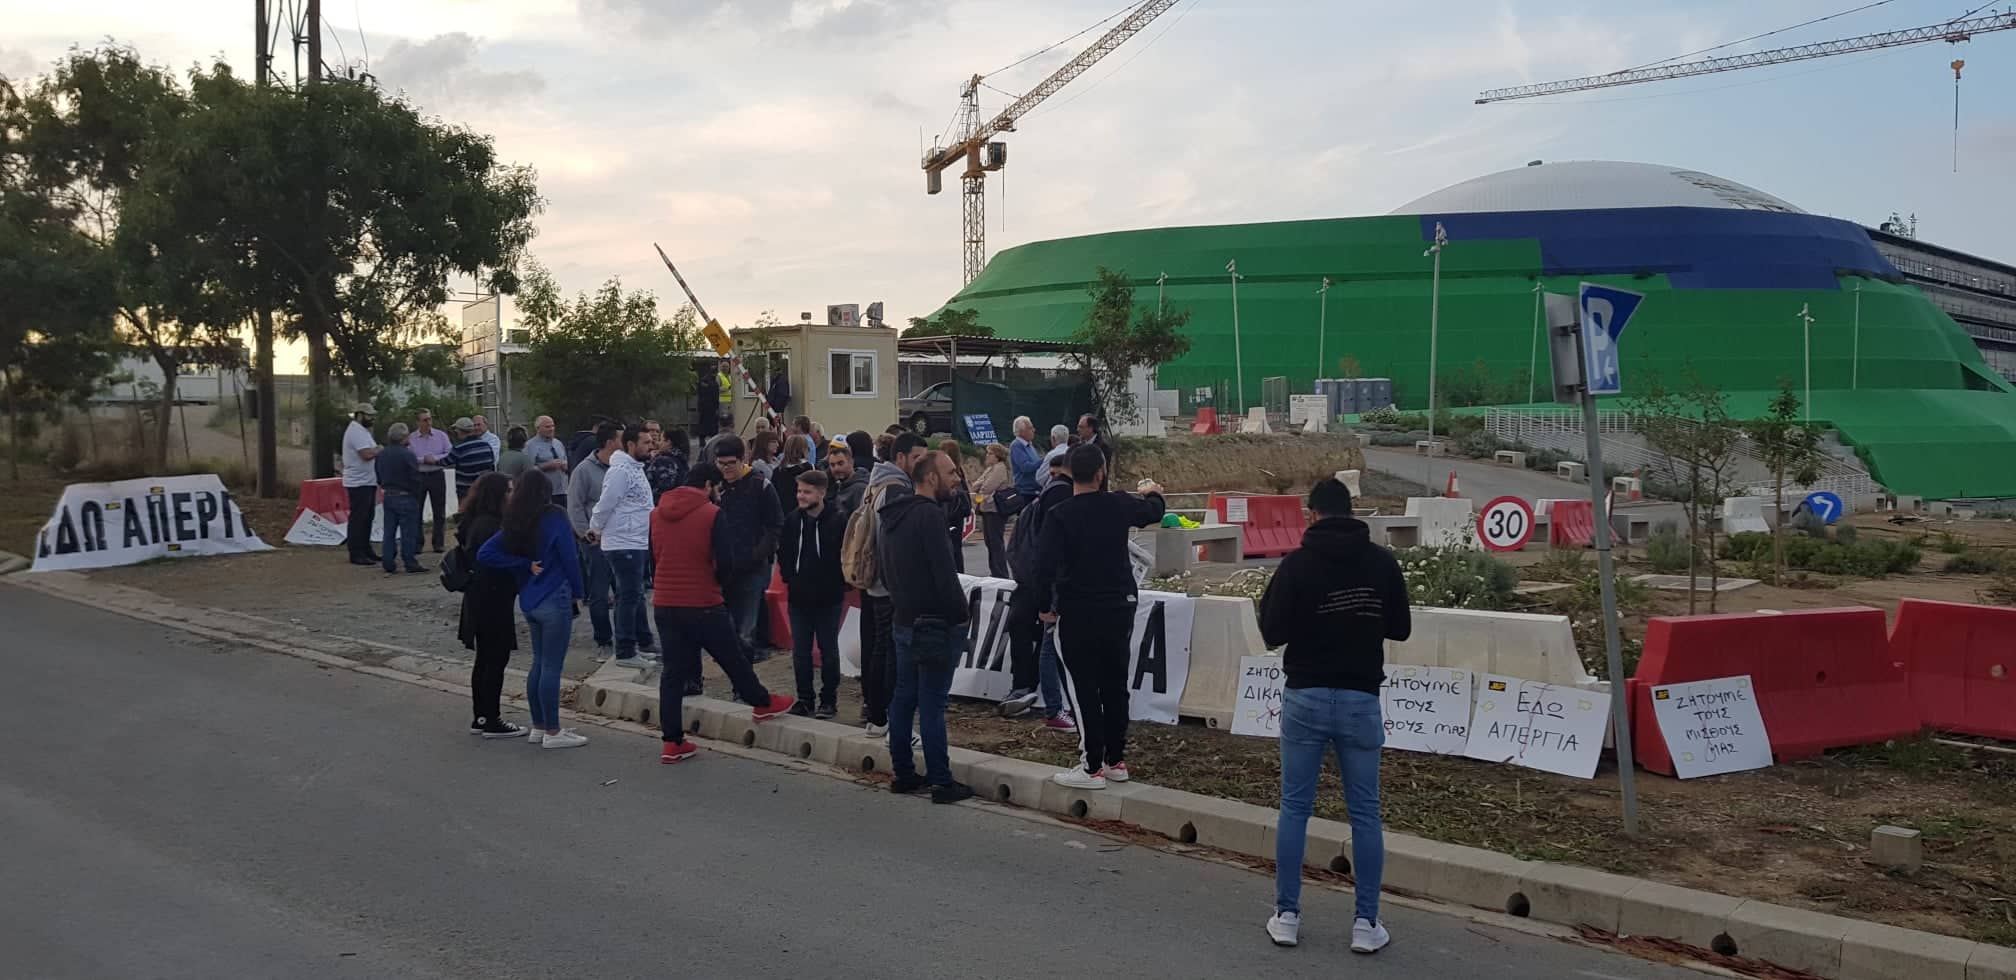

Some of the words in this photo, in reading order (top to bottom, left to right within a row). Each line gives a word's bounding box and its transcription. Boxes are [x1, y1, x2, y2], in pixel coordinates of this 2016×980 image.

[1587, 297, 1614, 380] P
[1489, 510, 1523, 539] 30
[1246, 667, 1286, 680] ΖΗΤΟ
[1244, 685, 1282, 703] ΔΙΚΑ
[1676, 689, 1747, 710] ΖΗΤΟΥΜΕ
[1393, 699, 1437, 713] ΤΟΥΣ
[1693, 707, 1733, 721] ΤΟΥΣ
[1384, 720, 1428, 735] ΘΟΥΣ
[1434, 723, 1467, 738] ΜΑΣ
[1488, 721, 1579, 751] ΑΠΕΡΓΙΑ
[1686, 724, 1745, 741] ΜΙΣΘΟΥΣ
[1710, 743, 1740, 756] ΜΑΣ
